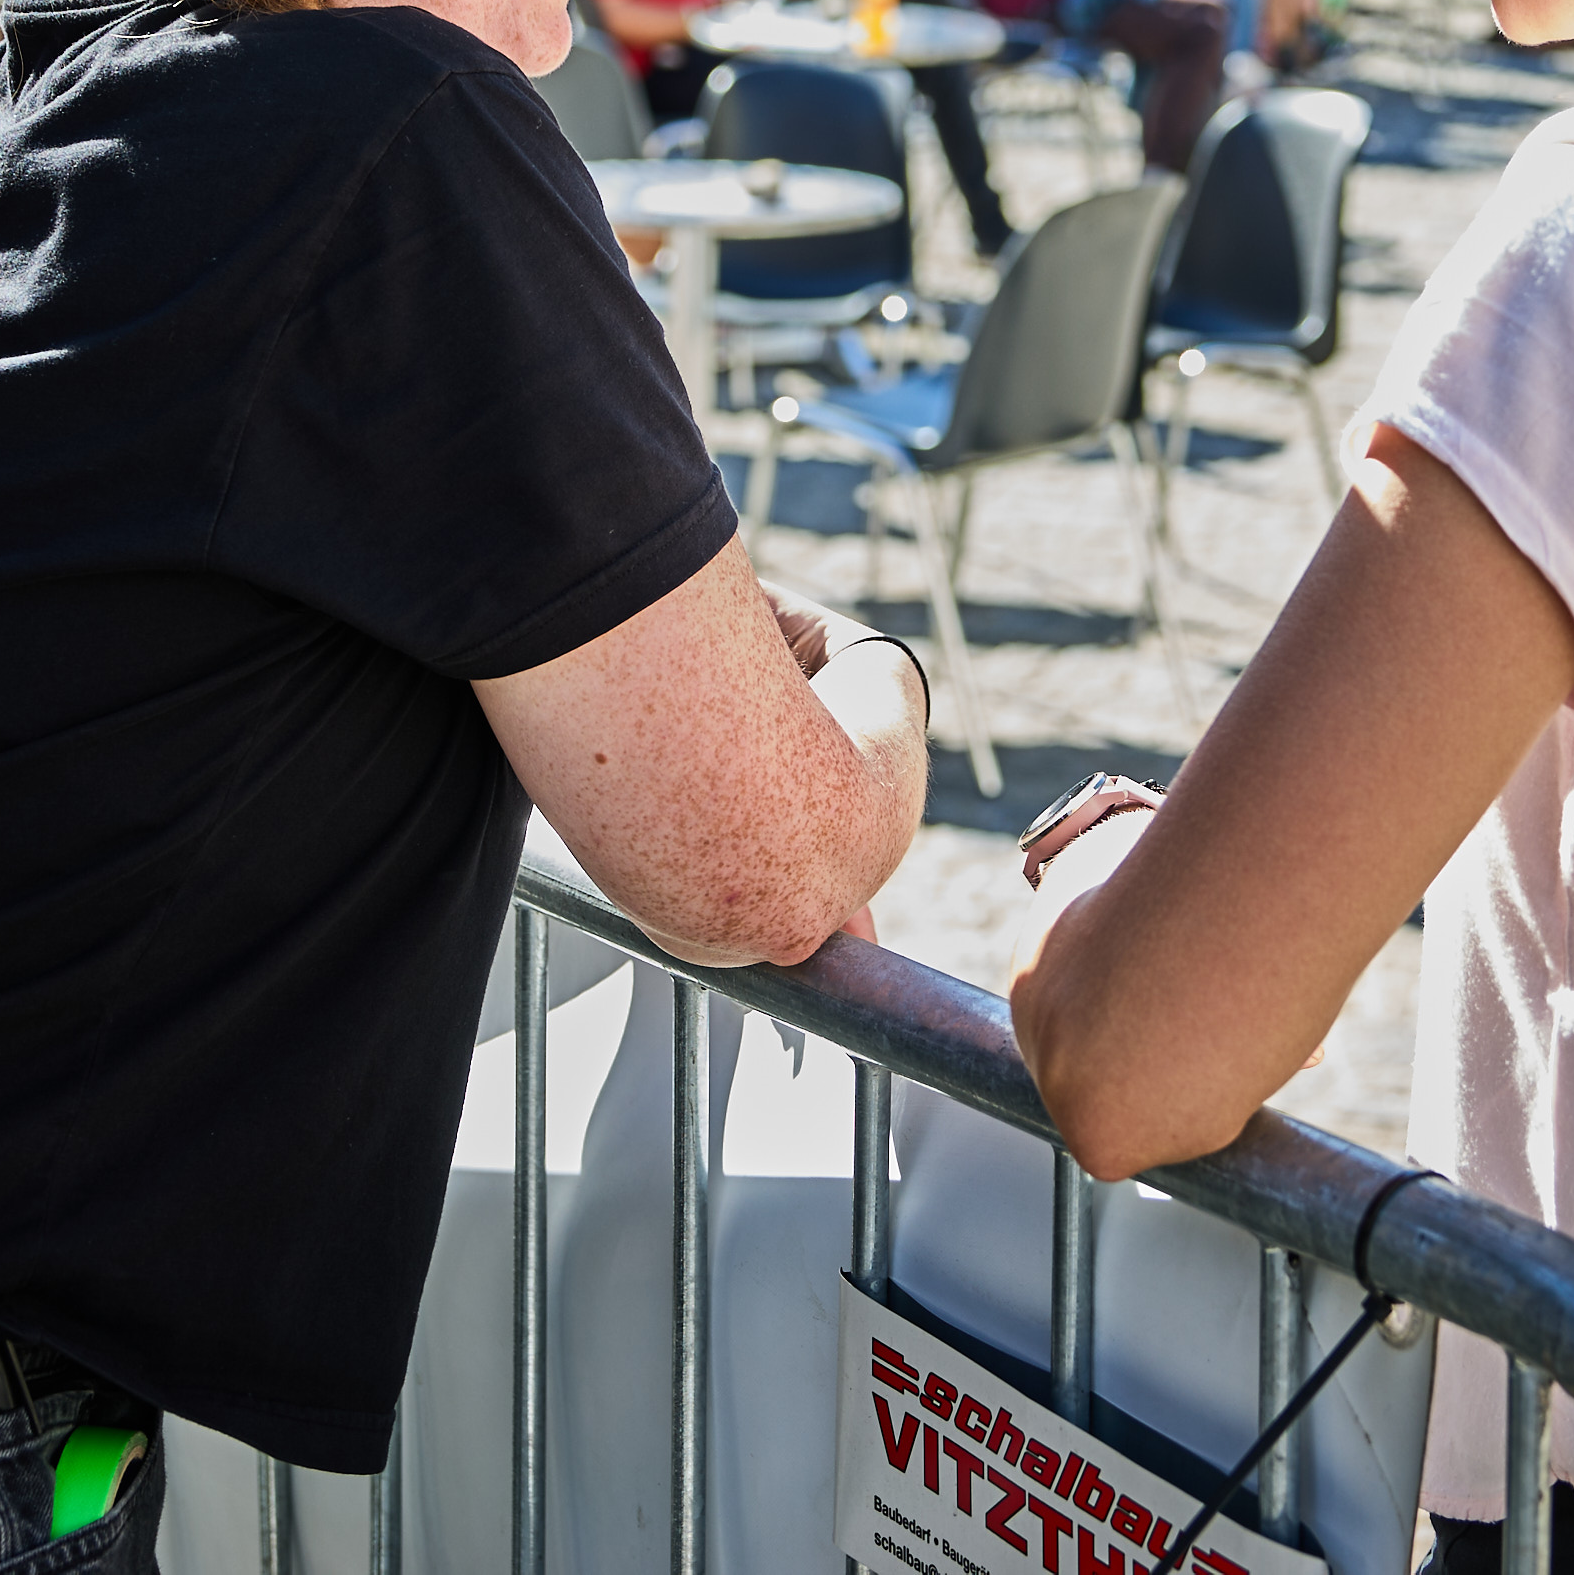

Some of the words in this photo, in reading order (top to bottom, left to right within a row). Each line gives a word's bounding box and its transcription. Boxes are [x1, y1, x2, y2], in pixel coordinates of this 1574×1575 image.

[871, 1391, 1155, 1575] VITZTH
[873, 1494, 931, 1545] Baubedarf
[919, 1371, 1193, 1571] schalbau
